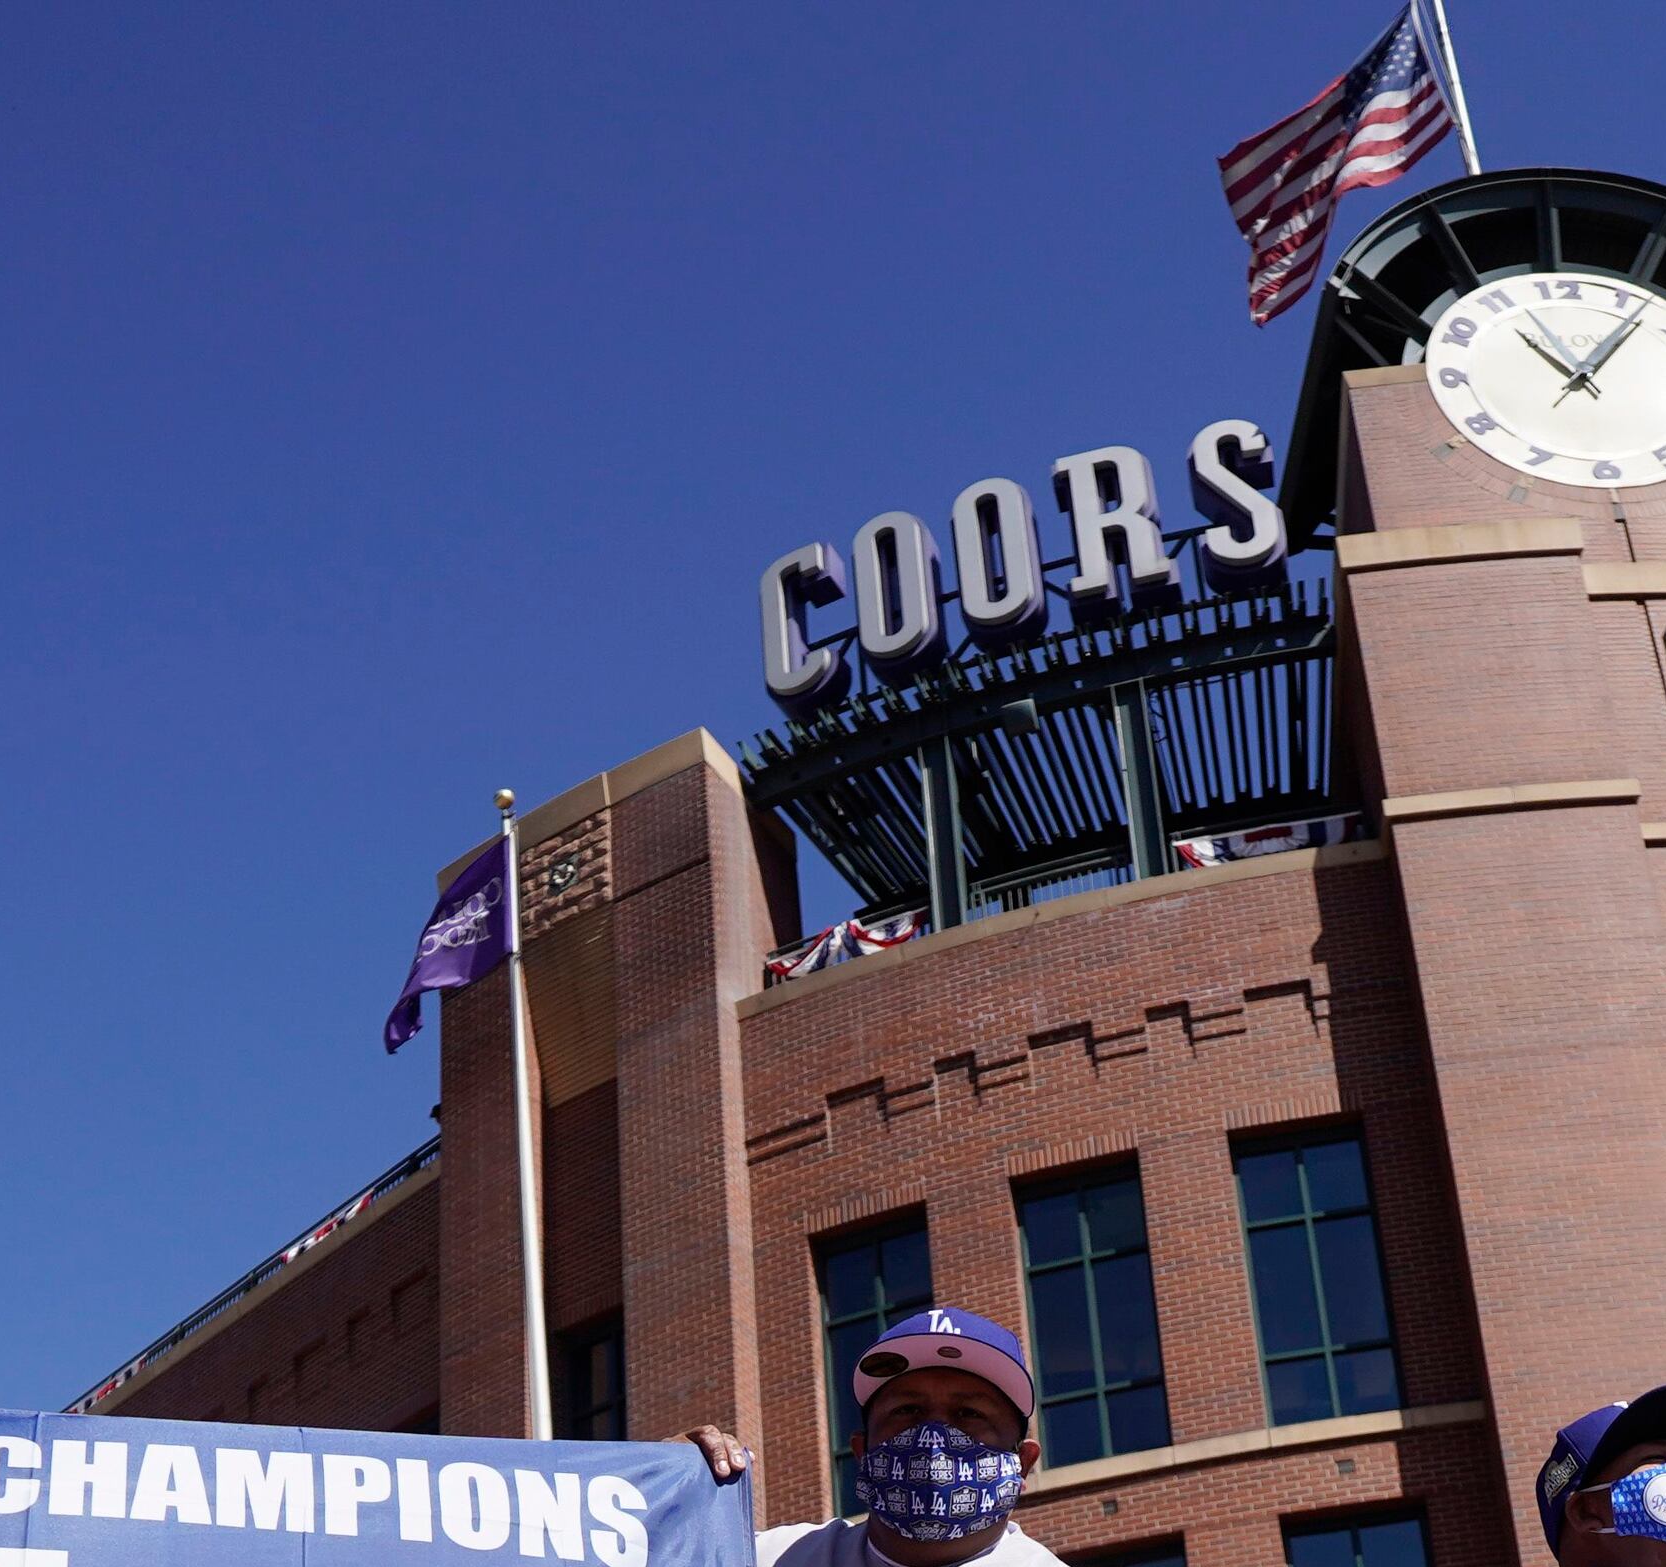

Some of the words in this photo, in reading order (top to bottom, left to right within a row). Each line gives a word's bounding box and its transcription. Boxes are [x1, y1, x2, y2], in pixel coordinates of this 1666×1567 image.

[1477, 290, 1517, 314] 11
[1534, 281, 1582, 300] 12
[1613, 289, 1633, 309] 1
[1441, 316, 1477, 348] 10
[1440, 367, 1469, 389] 9
[1465, 412, 1497, 435] 8
[1524, 446, 1555, 466] 7
[1592, 460, 1622, 480] 6
[760, 419, 1286, 696] COORS
[892, 1456, 905, 1480] LA
[958, 1457, 973, 1481] LA
[911, 1491, 925, 1515] LA
[930, 1491, 946, 1516] LA
[952, 1503, 975, 1515] SERIES
[953, 1493, 976, 1504] WORLD
[980, 1488, 995, 1513] LA
